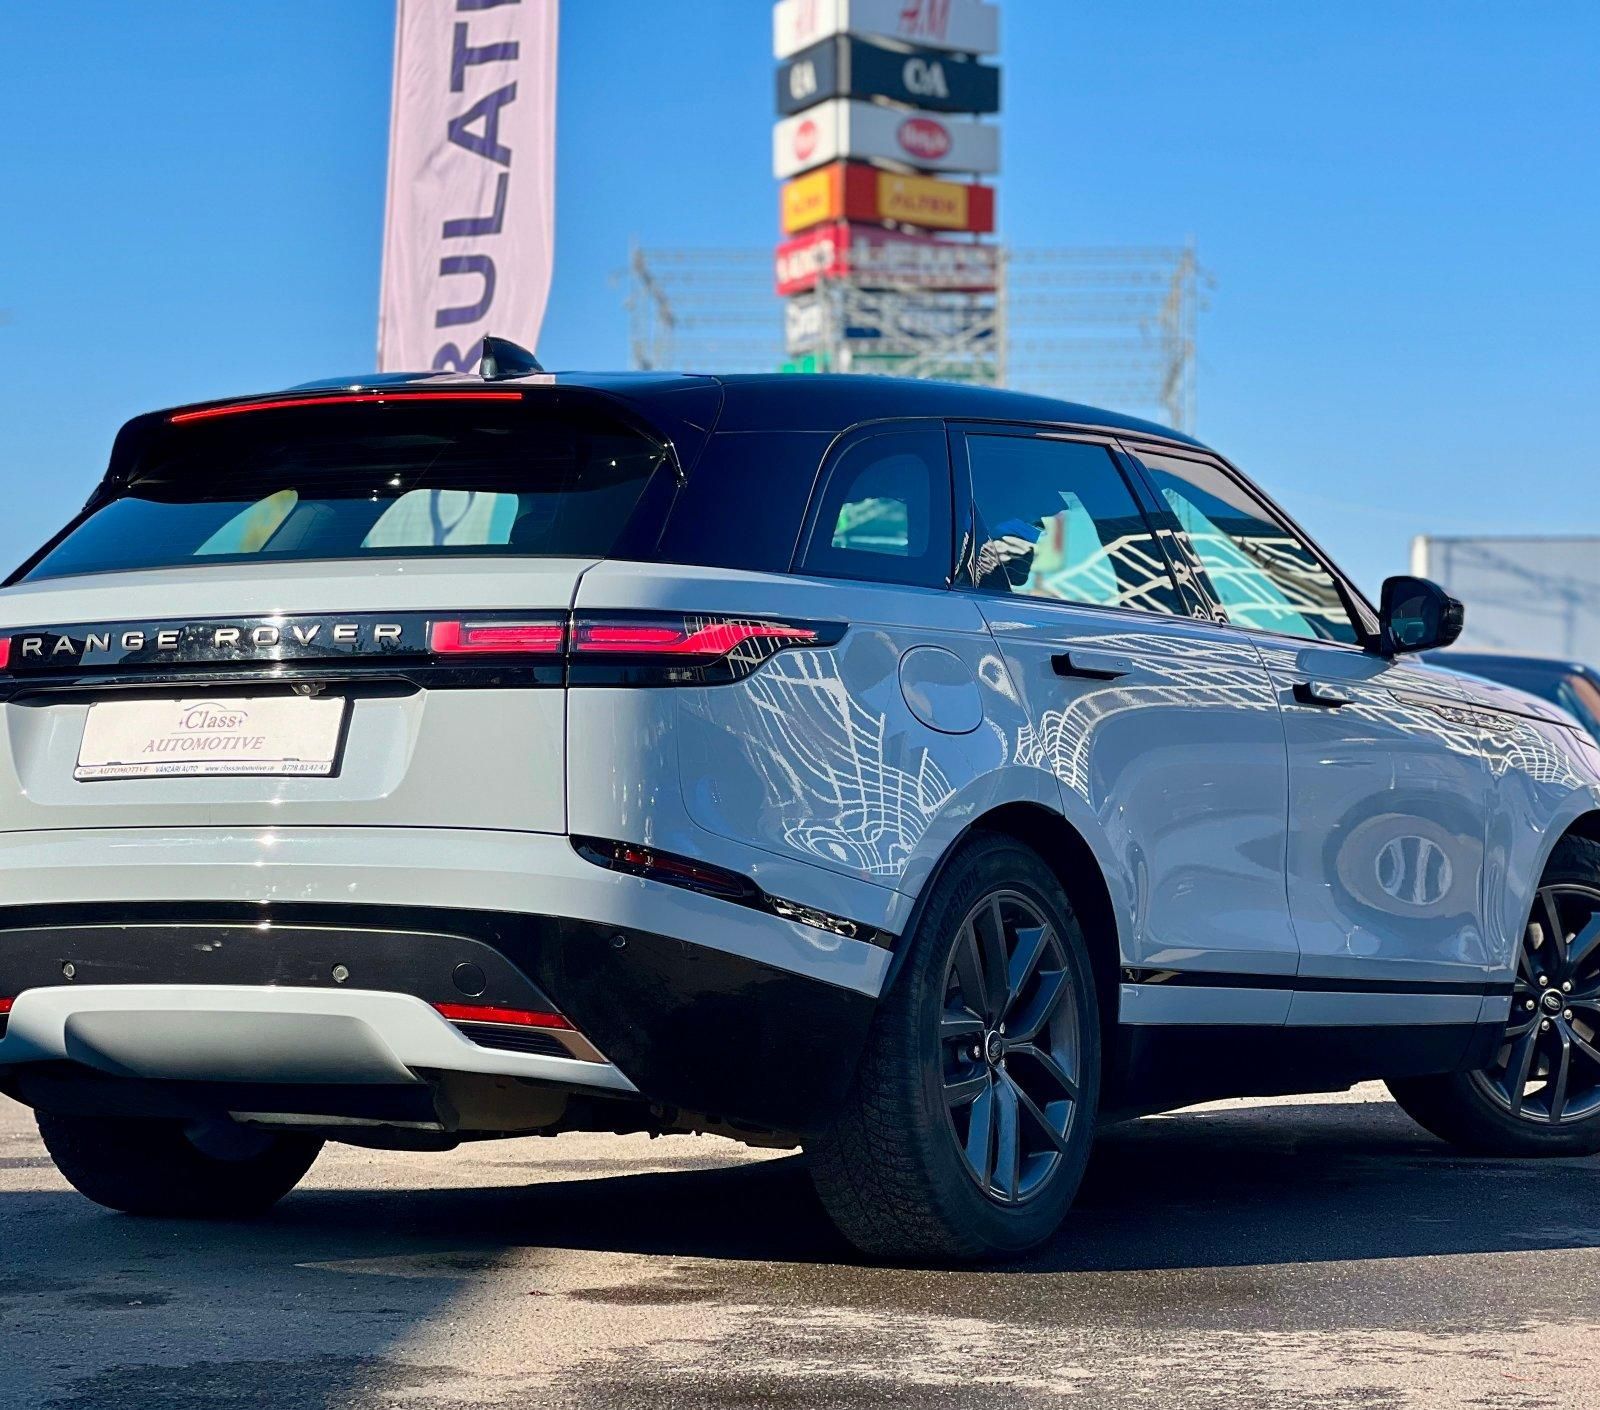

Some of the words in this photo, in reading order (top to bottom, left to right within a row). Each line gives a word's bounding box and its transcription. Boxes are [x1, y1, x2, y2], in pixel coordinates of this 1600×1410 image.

[432, 0, 521, 373] ULAT
[22, 629, 181, 657] RANGE
[214, 623, 403, 648] ROVER
[185, 709, 237, 730] Class
[142, 735, 266, 754] AUTOMOTIVE
[98, 766, 149, 775] AUTOMOTIVE
[181, 765, 199, 773] AUTO
